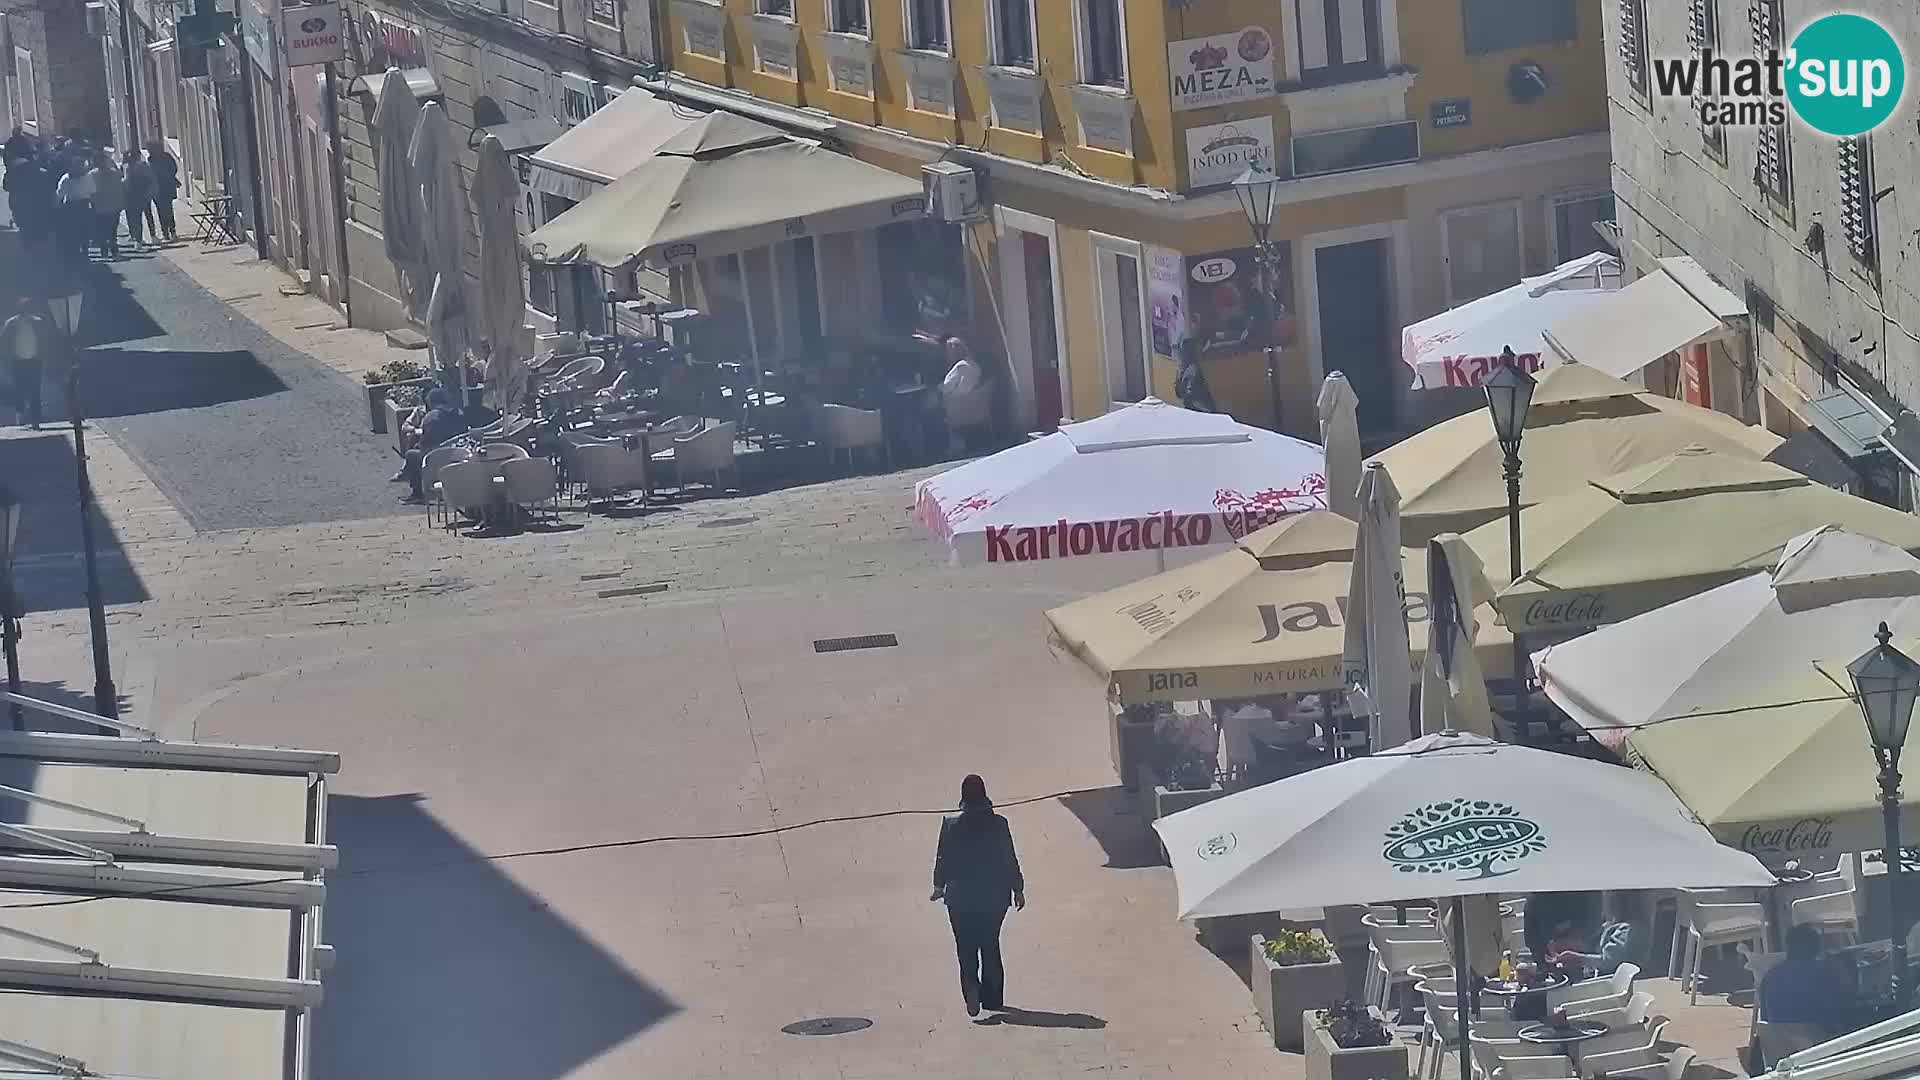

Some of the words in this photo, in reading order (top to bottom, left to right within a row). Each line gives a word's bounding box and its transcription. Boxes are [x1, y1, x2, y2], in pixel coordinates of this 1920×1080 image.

[1175, 66, 1253, 96] MEZA
[1192, 152, 1238, 168] ISPOD
[985, 510, 1212, 562] Karlovačko
[1254, 667, 1328, 683] NATURAL
[1423, 823, 1521, 853] RAUCH
